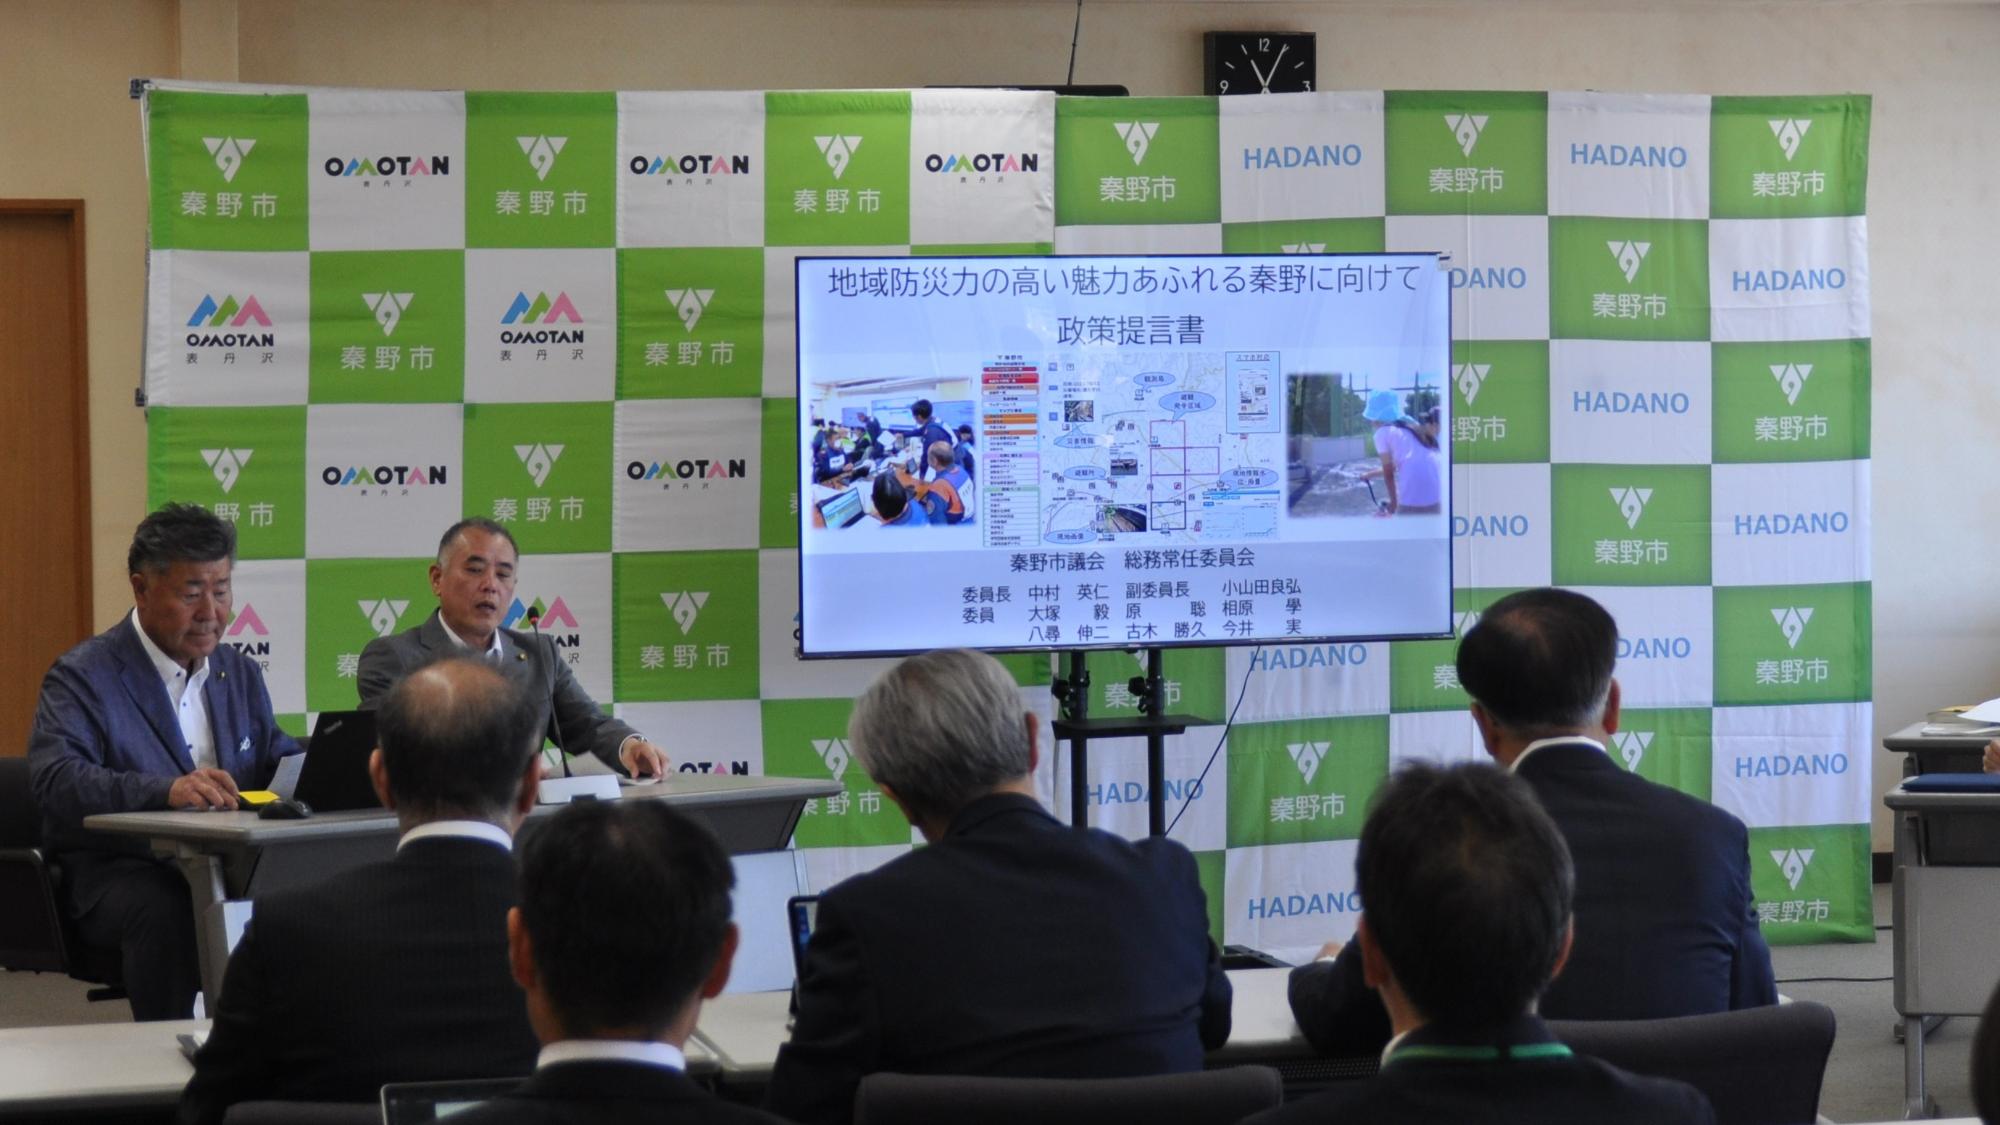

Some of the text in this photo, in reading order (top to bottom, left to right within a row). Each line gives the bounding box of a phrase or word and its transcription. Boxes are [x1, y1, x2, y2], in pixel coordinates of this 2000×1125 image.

[1259, 38, 1270, 52] 12
[1219, 80, 1229, 94] 9
[1302, 80, 1311, 93] 3
[325, 156, 449, 177] OMOTAN
[630, 154, 749, 176] OMOTAN
[925, 153, 1038, 173] OMOTAN
[1244, 143, 1362, 169] HADANO
[1570, 143, 1687, 169] HADANO
[1100, 176, 1176, 203] 秦野市
[1429, 167, 1504, 193] 秦野市
[1752, 171, 1826, 197] 秦野市
[181, 191, 278, 217] 秦野市
[495, 190, 588, 216] 秦野市
[793, 189, 881, 214] 秦野市
[828, 263, 1419, 297] 地域防災力の高い魅力あふれる秦野に向けて
[1452, 266, 1527, 289] DANO
[1732, 267, 1846, 292] HADANO
[1592, 293, 1667, 319] 秦野市
[186, 333, 274, 348] OMOTAN
[500, 329, 584, 344] OMOTAN
[1057, 315, 1205, 346] 政策提言書
[185, 352, 273, 365] 表丹沢
[340, 345, 435, 370] 秦野市
[500, 348, 584, 361] 表丹沢
[644, 341, 735, 366] 秦野市
[1573, 391, 1690, 415] HADANO
[1452, 415, 1507, 442] 野市
[1754, 415, 1828, 442] 秦野市
[322, 465, 446, 486] OMOTAN
[627, 459, 745, 480] OMOTAN
[493, 496, 585, 522] 秦野市
[1453, 515, 1529, 537] DANO
[1734, 511, 1849, 536] HADANO
[1010, 547, 1255, 573] 秦野市議会 総務常任委員会
[1594, 539, 1669, 565] 秦野市
[963, 578, 1302, 604] 委員長 中村 英仁 副委員長 小山田良弘
[963, 597, 1302, 624] 委員 大塚 毅 原 聡 相原 學
[1029, 618, 1301, 642] 八尋 伸二 古木 勝久 今井 実
[640, 643, 730, 670] 秦野市
[1250, 643, 1368, 672] HADANO
[1615, 637, 1691, 659] DANO
[1755, 657, 1829, 685] 秦野市
[1104, 680, 1182, 709] 秦市
[1735, 752, 1849, 778] HADANO
[1086, 778, 1205, 806] HADNO
[1270, 792, 1346, 824] 秦野市
[1248, 890, 1364, 920] HADANO
[1757, 898, 1830, 924] 秦野市
